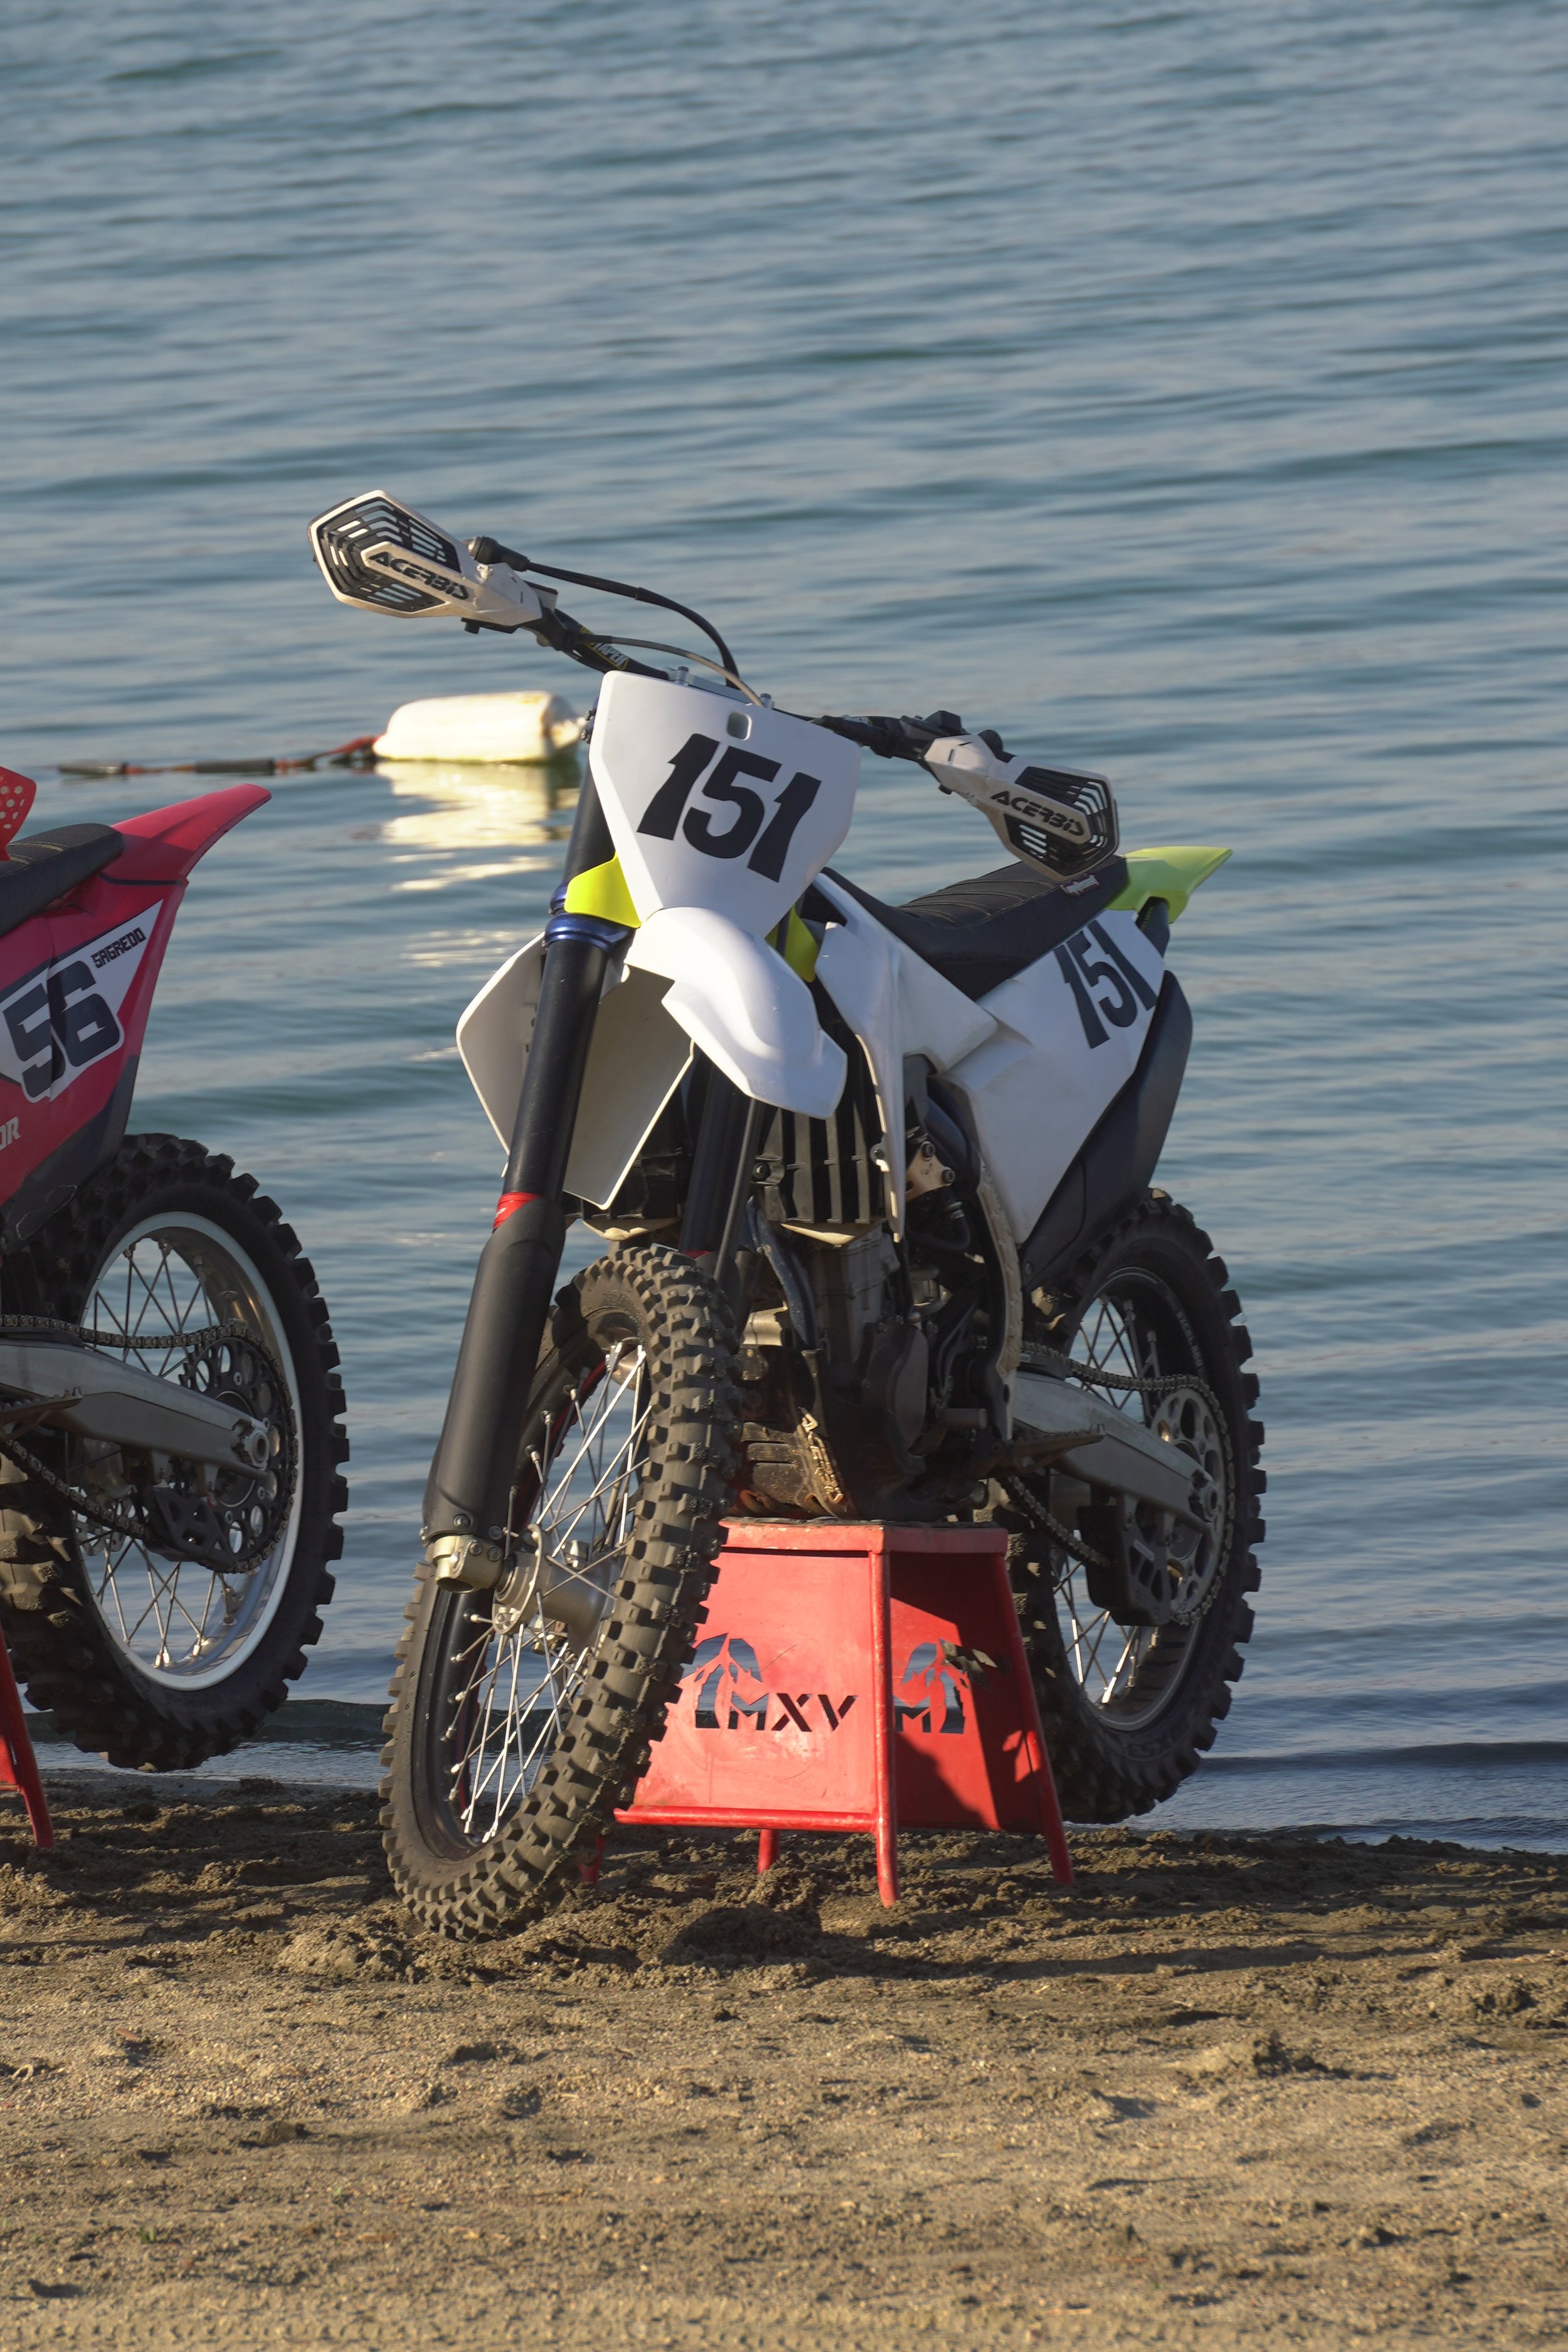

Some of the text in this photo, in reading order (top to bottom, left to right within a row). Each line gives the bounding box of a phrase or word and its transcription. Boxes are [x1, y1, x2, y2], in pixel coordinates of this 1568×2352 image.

[368, 551, 469, 600] ACERBIS
[636, 733, 822, 883] 151
[990, 790, 1084, 836] ACERBIS
[90, 927, 147, 969] SAGREDO
[1053, 919, 1159, 1049] 151
[2, 960, 120, 1098] 56
